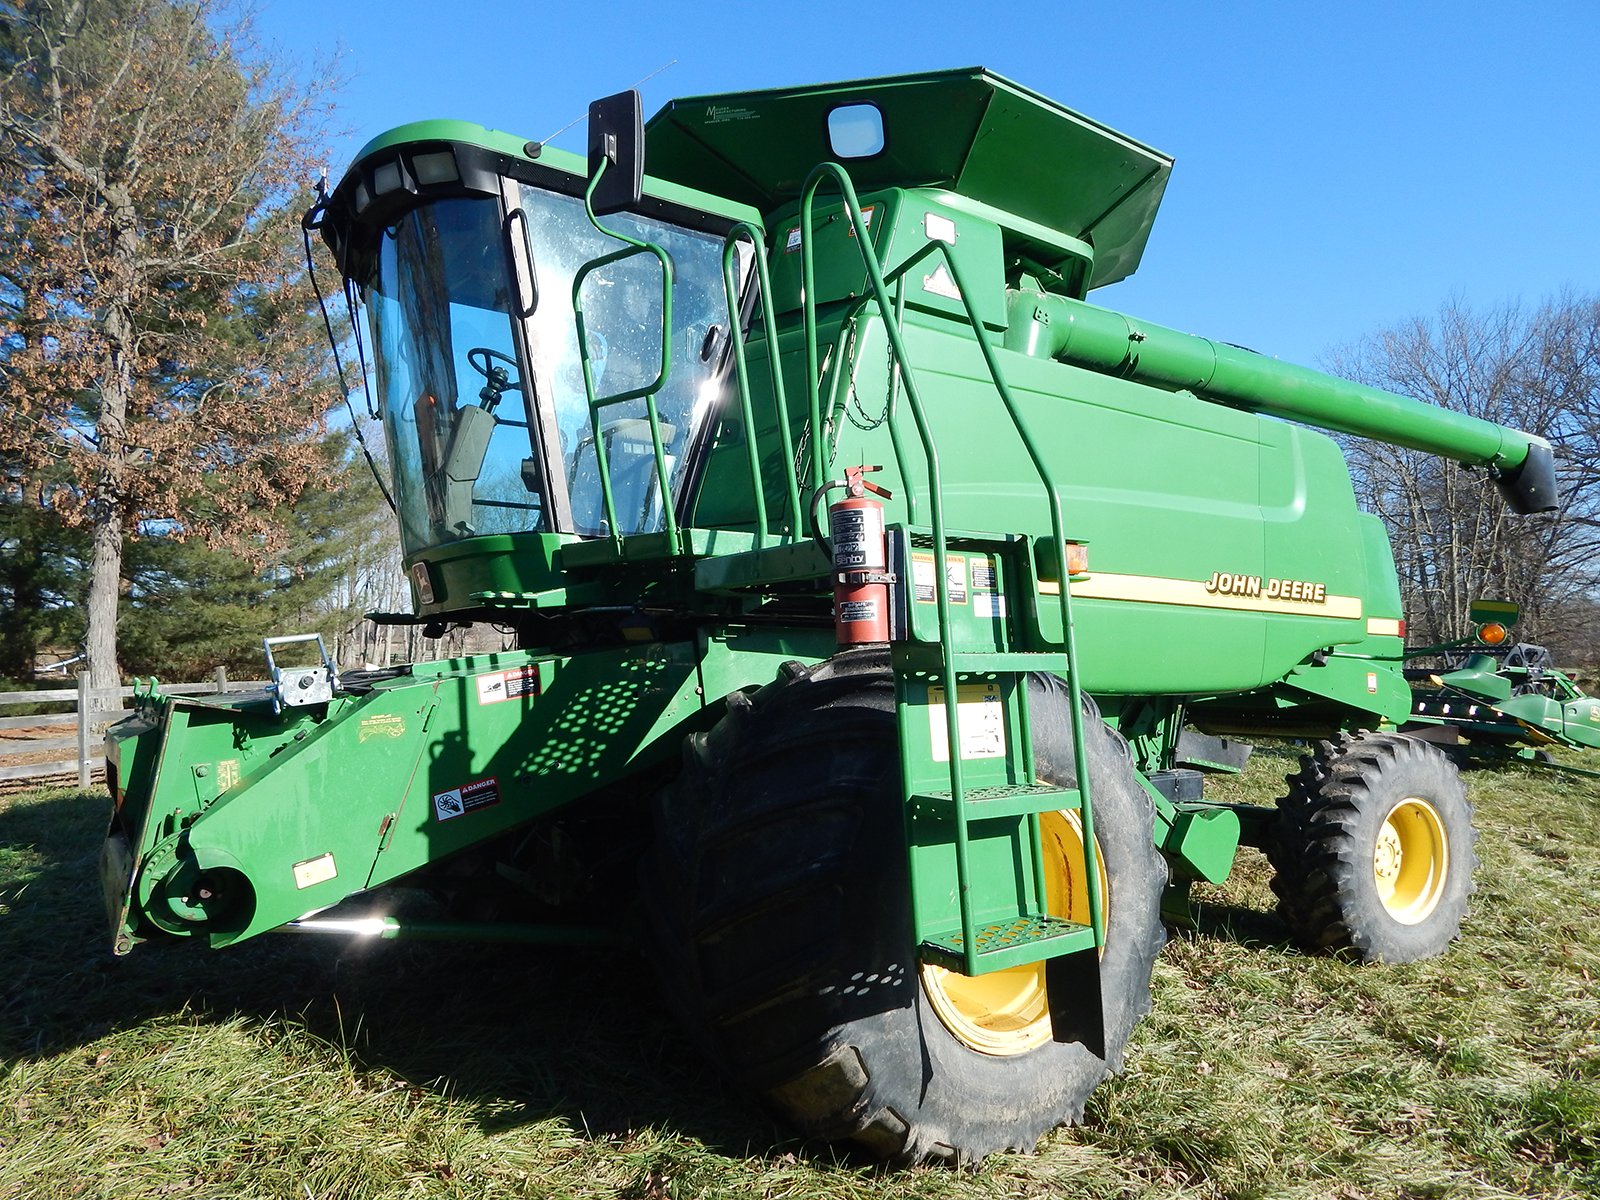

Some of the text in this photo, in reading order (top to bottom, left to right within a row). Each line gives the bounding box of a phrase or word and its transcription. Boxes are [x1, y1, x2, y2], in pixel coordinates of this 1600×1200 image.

[1205, 571, 1326, 604] JOHN DEERE
[467, 778, 496, 792] DANGER
